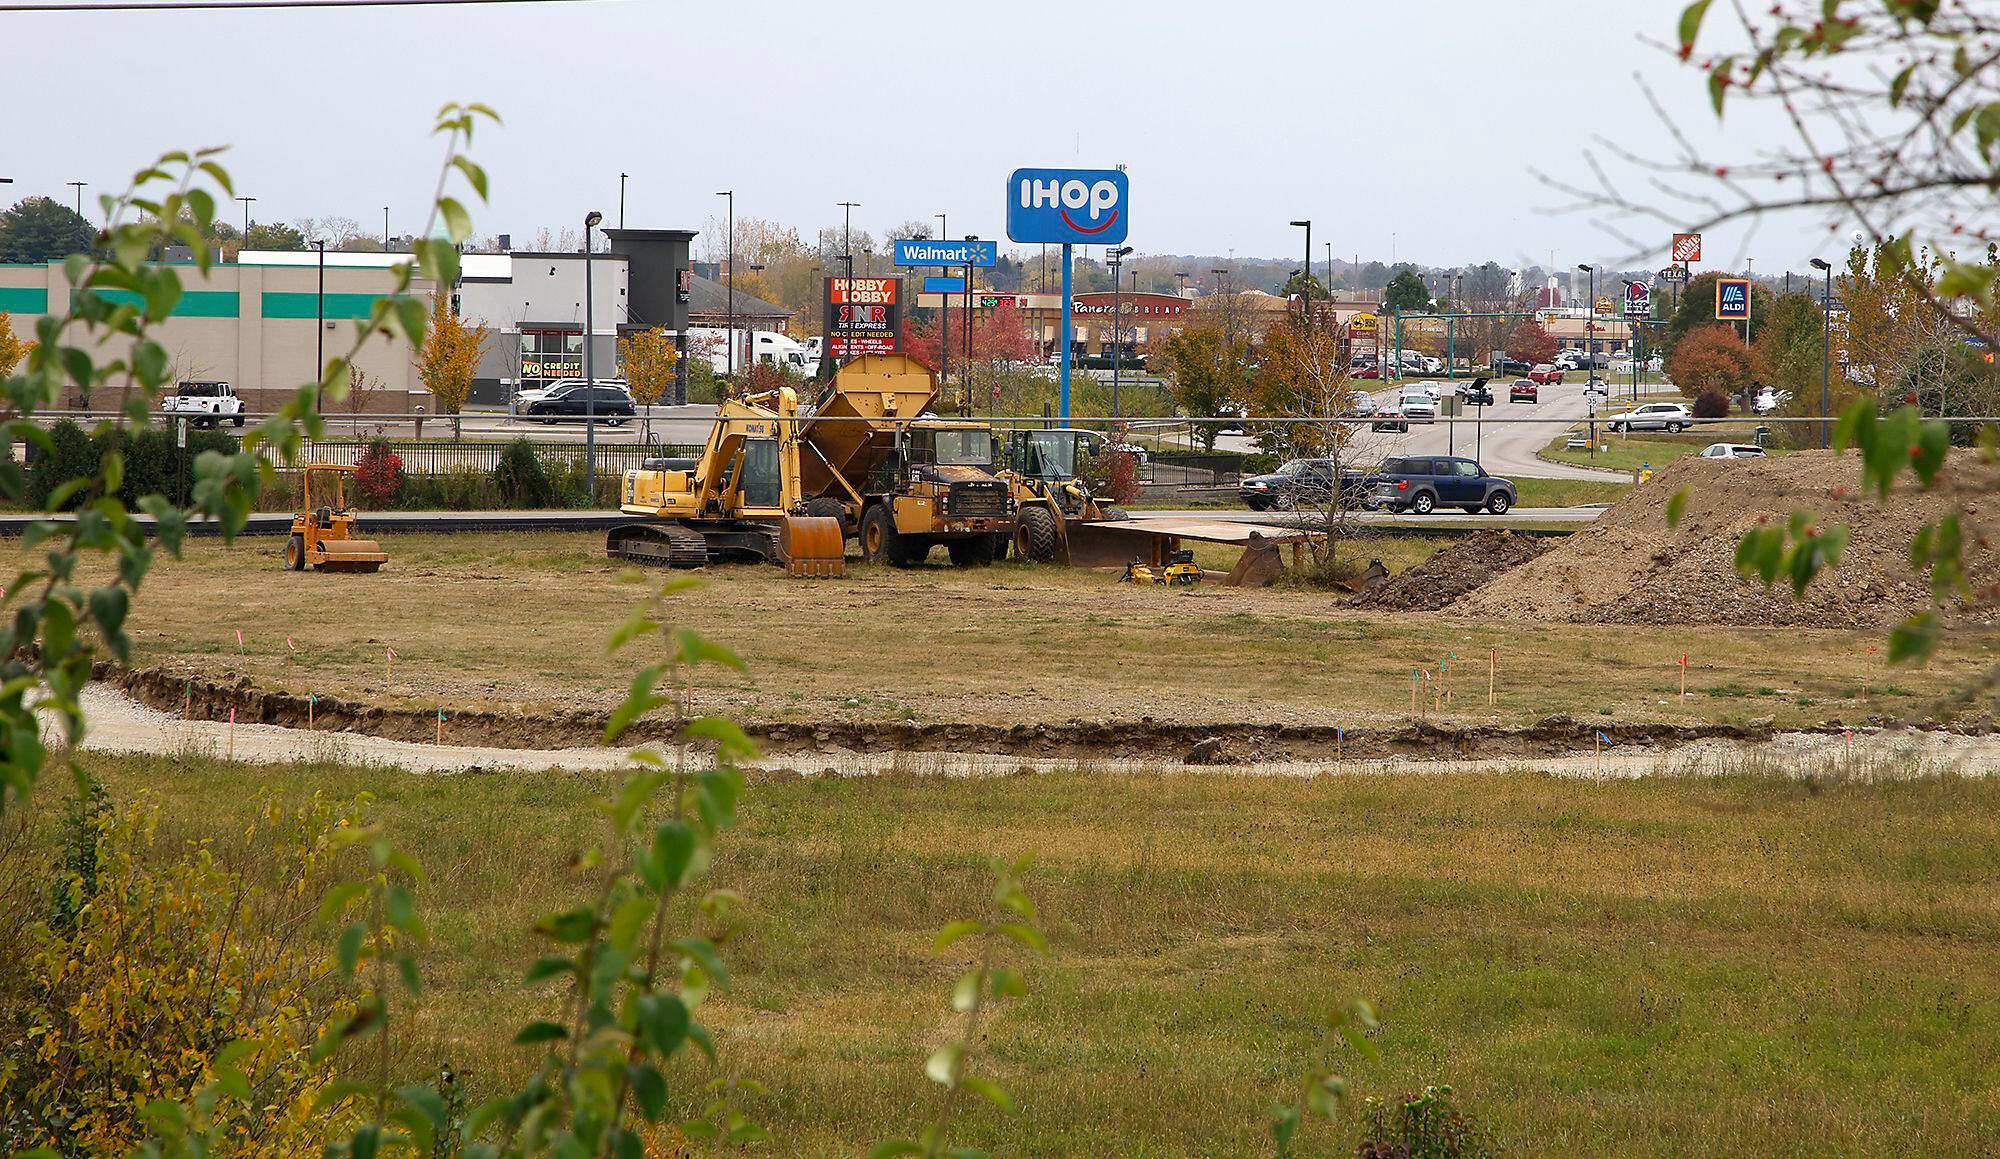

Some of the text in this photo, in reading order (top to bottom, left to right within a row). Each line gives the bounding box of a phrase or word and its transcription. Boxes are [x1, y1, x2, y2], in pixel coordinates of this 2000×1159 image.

[1021, 179, 1118, 220] IHOP
[903, 246, 967, 260] Walmart
[1673, 234, 1700, 260] HOME
[834, 279, 887, 291] HOBBY
[842, 291, 892, 303] LOBBY
[1072, 301, 1181, 314] Panera BREAD
[1722, 303, 1745, 311] ALDI
[522, 362, 580, 374] NO CREDIT
[543, 369, 581, 377] NEEDED
